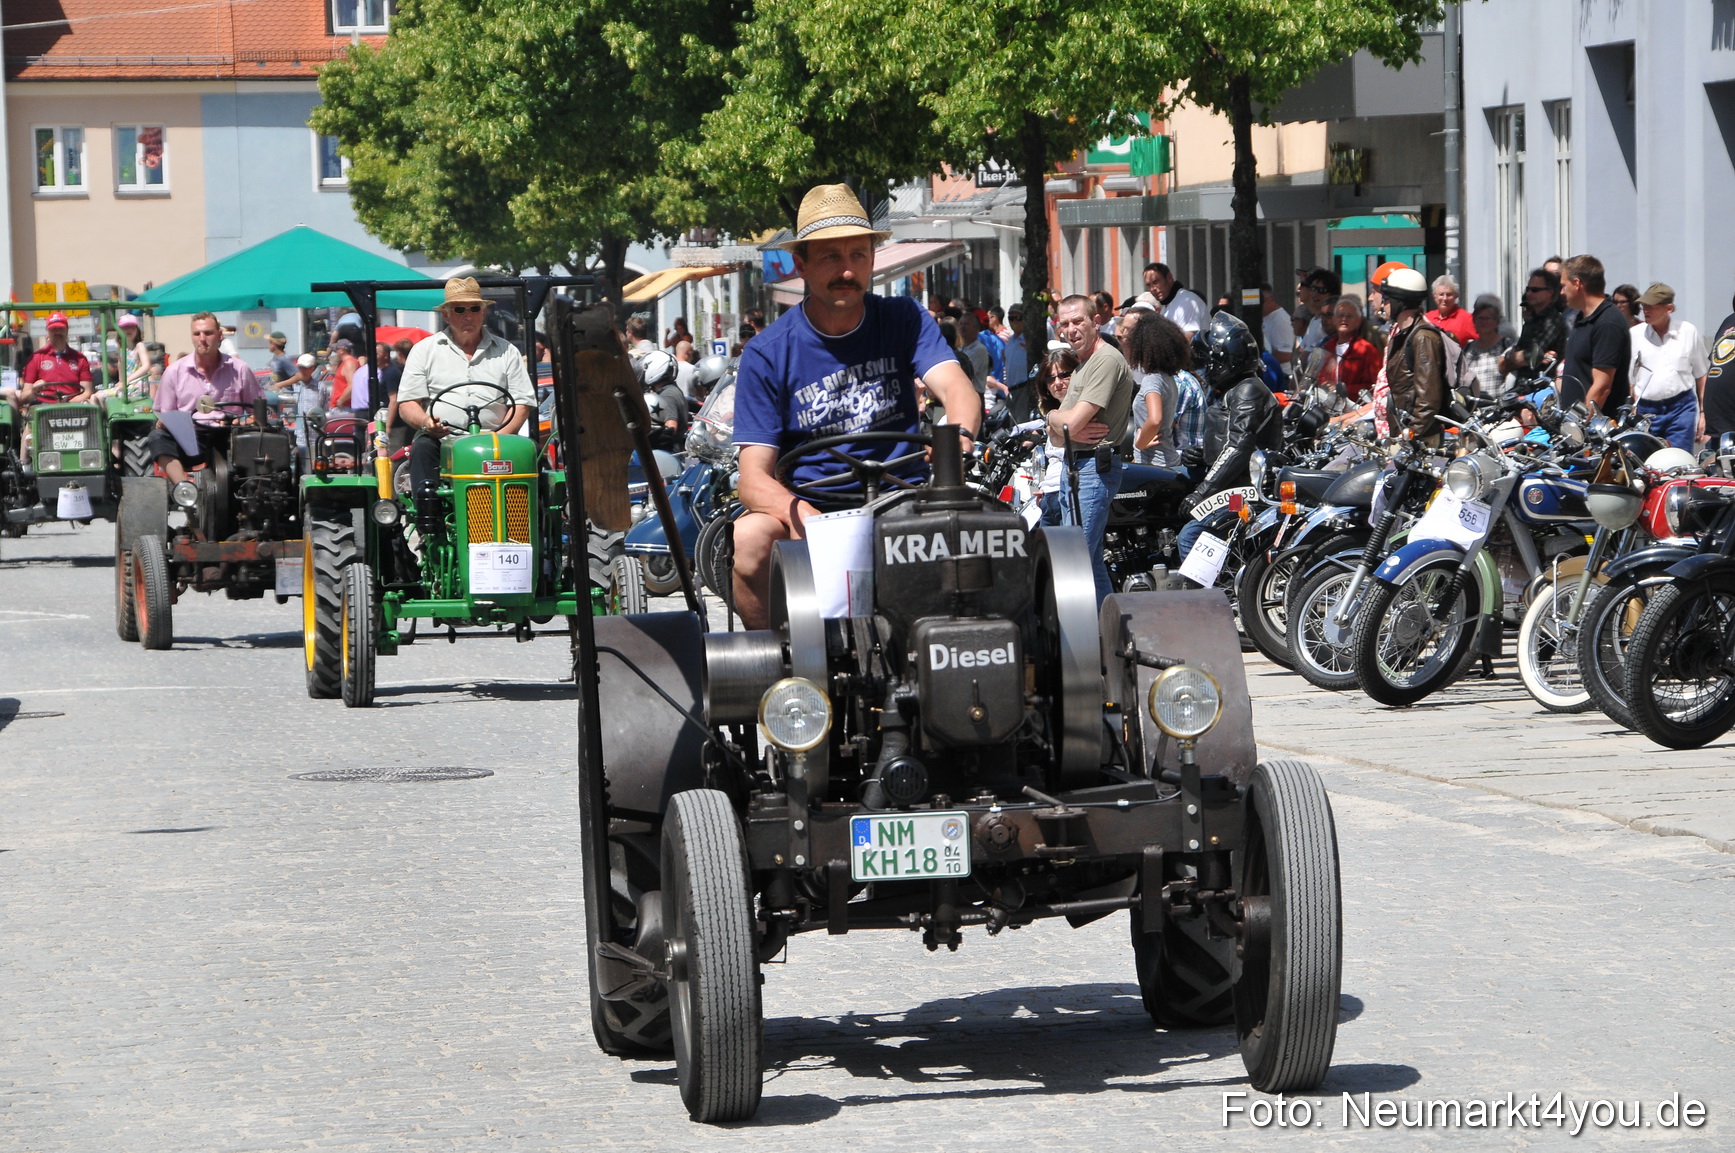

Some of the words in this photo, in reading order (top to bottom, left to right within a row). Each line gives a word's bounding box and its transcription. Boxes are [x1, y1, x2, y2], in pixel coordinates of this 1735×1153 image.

[714, 344, 725, 355] P
[794, 381, 821, 406] THE
[821, 363, 865, 393] RIGHT
[811, 376, 862, 423] Surf
[48, 417, 88, 428] FENDT
[62, 433, 75, 442] NM
[54, 441, 68, 449] SW
[1458, 508, 1478, 526] 556
[1194, 541, 1216, 559] 276
[498, 553, 520, 565] 140
[928, 641, 1016, 671] Diesel
[877, 819, 916, 848] NM
[858, 835, 867, 845] D
[943, 846, 961, 858] 04
[945, 862, 961, 874] 10
